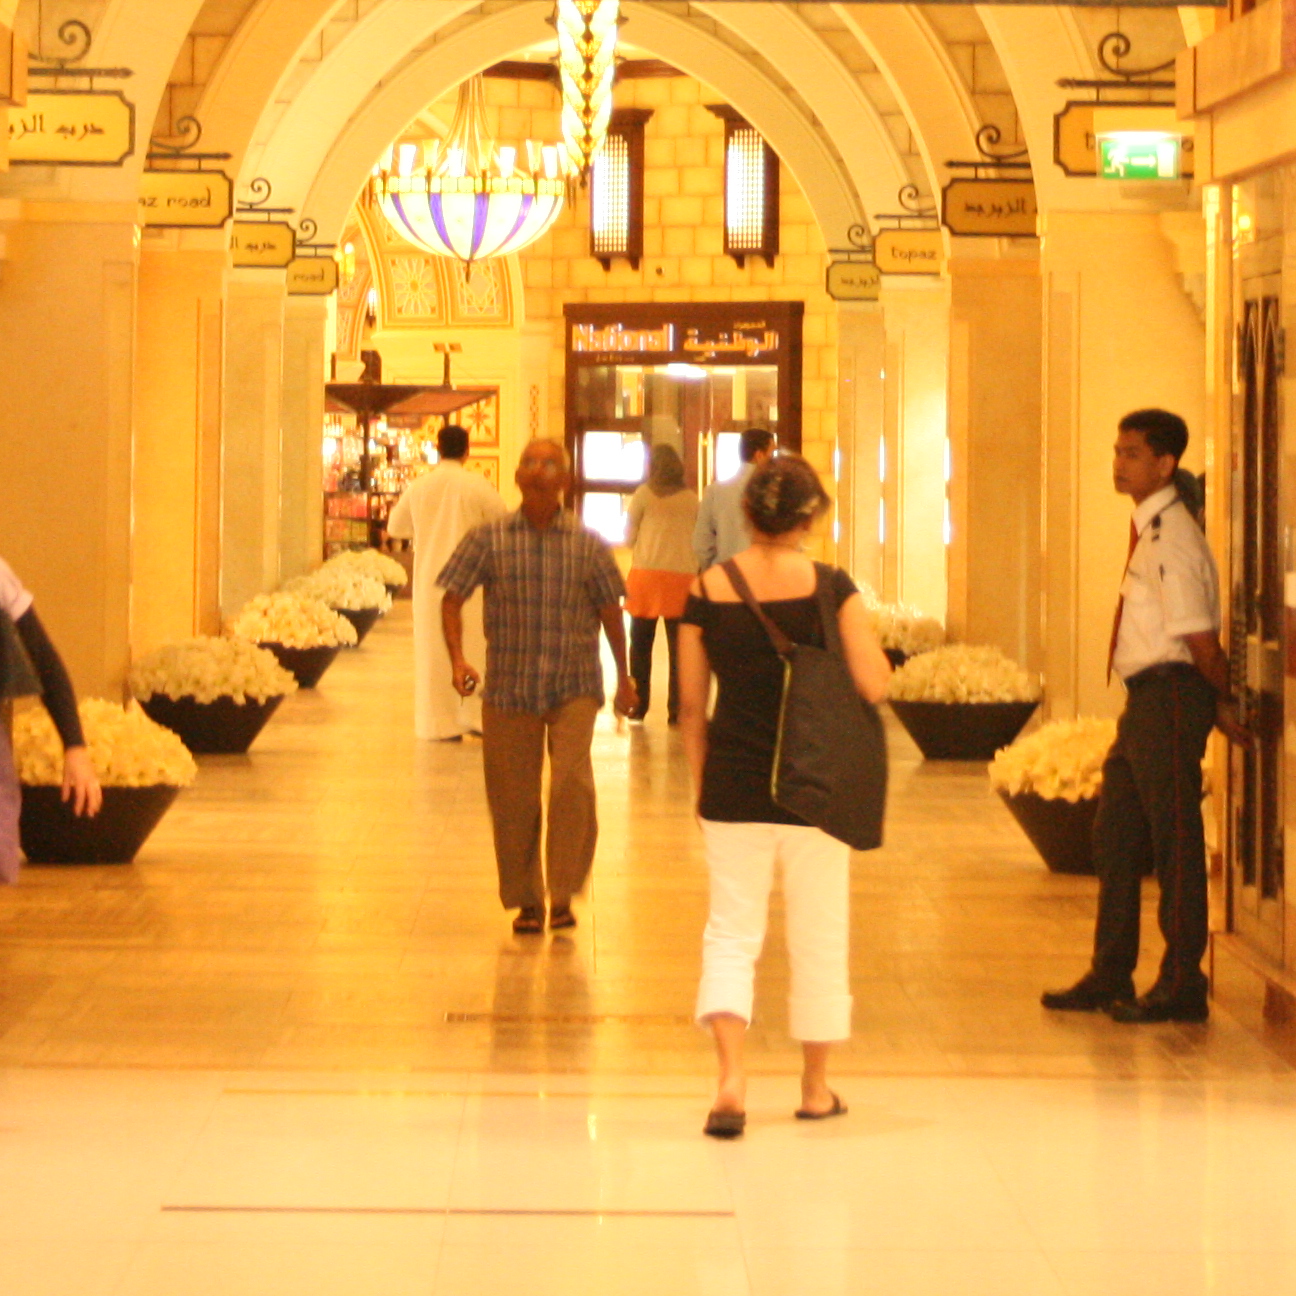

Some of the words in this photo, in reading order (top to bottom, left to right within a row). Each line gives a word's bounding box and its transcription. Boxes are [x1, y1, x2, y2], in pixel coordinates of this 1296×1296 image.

[167, 186, 211, 208] road
[890, 245, 937, 264] topaz
[293, 267, 325, 282] road
[571, 322, 675, 352] National
